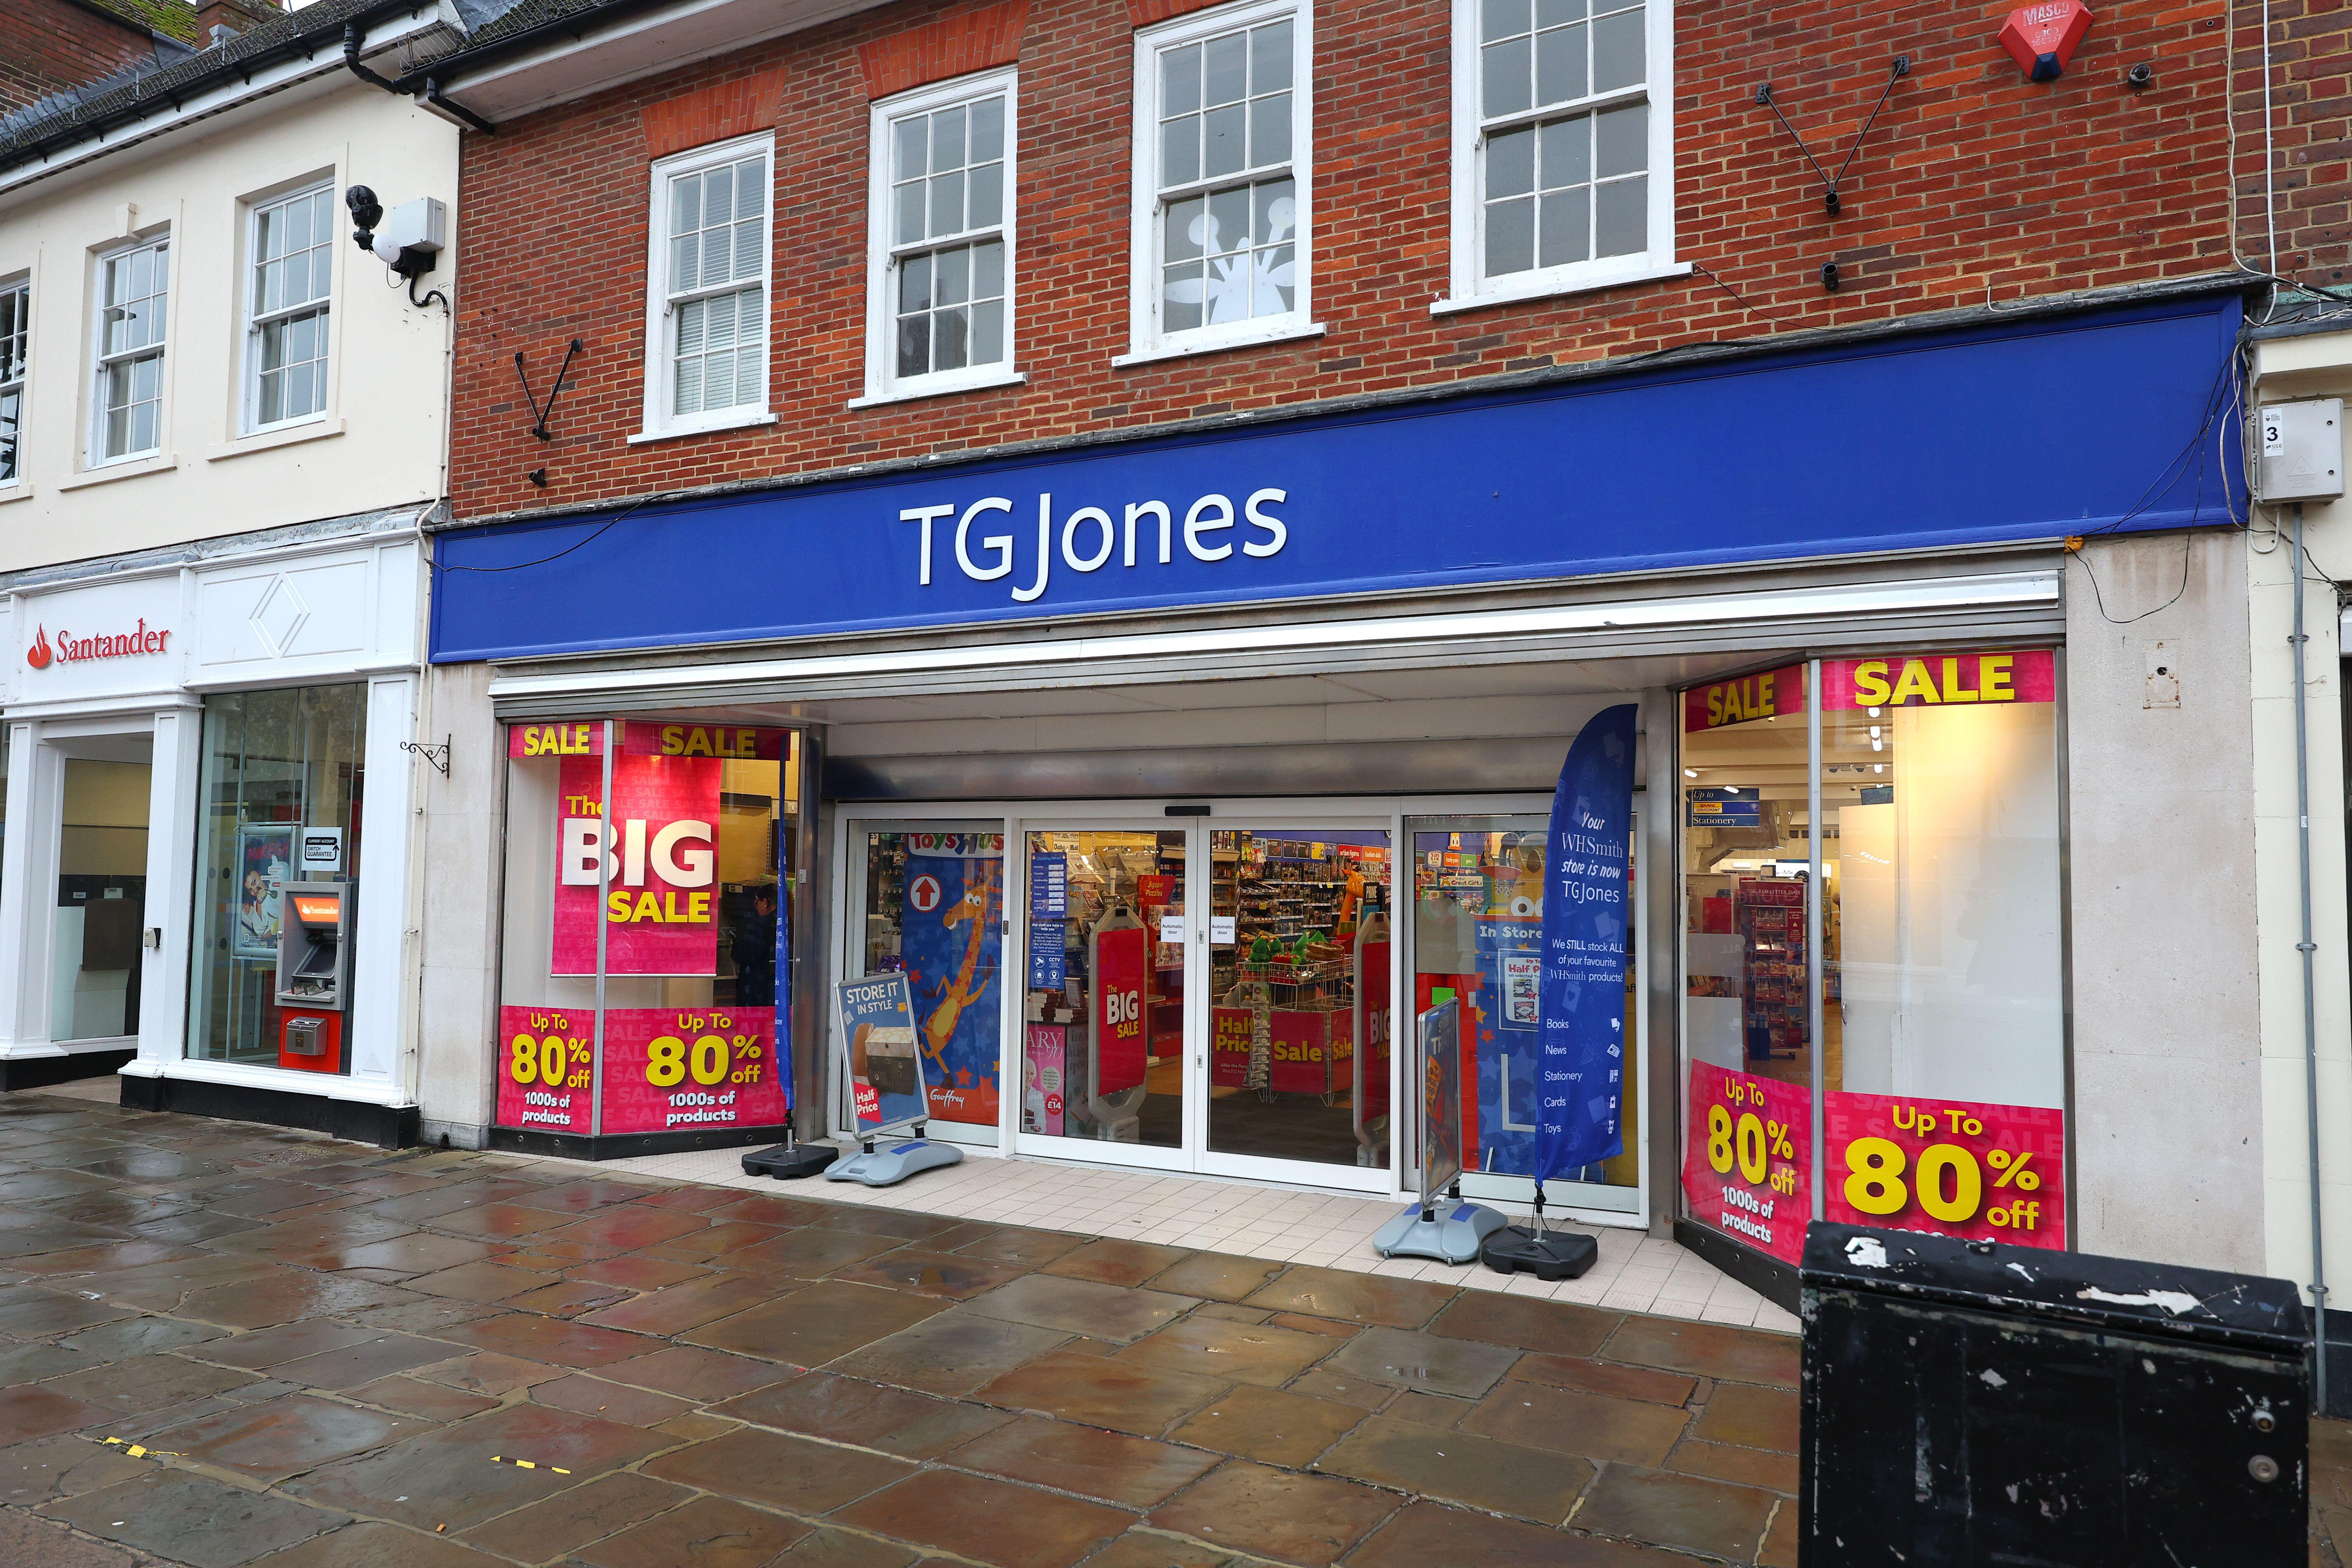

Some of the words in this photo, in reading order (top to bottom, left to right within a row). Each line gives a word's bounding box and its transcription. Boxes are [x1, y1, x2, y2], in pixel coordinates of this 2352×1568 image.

[2023, 2, 2069, 26] MASCO
[2267, 427, 2278, 442] 3
[57, 618, 169, 663] Santander
[1854, 655, 2015, 706] SALE
[1707, 673, 1774, 726] SALE
[524, 724, 590, 756] SALE
[661, 726, 756, 758] SALE
[1693, 791, 1705, 800] Up
[1582, 812, 1605, 830] Your
[1693, 817, 1736, 826] Stationery
[562, 818, 713, 888] BIG
[1054, 844, 1065, 852] Daily
[1562, 832, 1623, 858] WHSmith
[1561, 859, 1585, 875] store
[1587, 860, 1598, 876] is
[1600, 865, 1621, 879] now
[1148, 881, 1164, 889] Jigsaw
[1366, 886, 1377, 899] PRIME
[607, 890, 711, 923] SALE
[1480, 926, 1497, 937] In
[1502, 926, 1542, 939] Store
[1552, 939, 1565, 949] We
[1566, 940, 1586, 950] STILL
[1588, 942, 1608, 952] stock
[1609, 943, 1624, 953] ALL
[1509, 964, 1530, 973] Half
[1558, 954, 1567, 964] of
[1568, 956, 1583, 967] your
[1584, 956, 1616, 967] favourite
[1550, 969, 1586, 980] WHSmith
[1589, 972, 1623, 982] products!
[846, 984, 886, 1004] STORE
[887, 982, 898, 997] IT
[1107, 985, 1117, 993] The
[857, 1004, 867, 1015] IN
[868, 999, 893, 1013] STYLE
[1107, 990, 1138, 1025] BIG
[531, 1012, 549, 1033] Up
[551, 1013, 568, 1030] To
[678, 1013, 704, 1033] Up
[709, 1013, 731, 1028] To
[1117, 1021, 1139, 1038] SALE
[1219, 1016, 1254, 1034] Half
[1547, 1018, 1569, 1029] Books
[1046, 1045, 1063, 1060] 90
[1274, 1040, 1322, 1062] Sale
[1333, 1037, 1353, 1060] Sale
[1377, 1041, 1390, 1059] SAL
[1546, 1045, 1567, 1055] News
[511, 1033, 591, 1086] 80%
[645, 1034, 762, 1087] 80%
[567, 1069, 590, 1089] off
[731, 1064, 760, 1084] off
[1544, 1070, 1582, 1082] Stationery
[525, 1091, 557, 1107] 1000s
[559, 1094, 571, 1108] of
[668, 1093, 715, 1107] 1000s
[718, 1090, 736, 1105] of
[856, 1089, 875, 1104] Half
[930, 1089, 965, 1109] Geoffrey
[1726, 1076, 1744, 1106] Up
[1746, 1082, 1764, 1107] To
[857, 1103, 878, 1116] Price
[1047, 1101, 1061, 1110] £14
[1544, 1096, 1566, 1107] Cards
[522, 1109, 571, 1125] products
[666, 1109, 736, 1127] products
[1893, 1105, 1936, 1137] Up
[1943, 1109, 1982, 1136] To
[1544, 1123, 1561, 1135] Toys
[1708, 1104, 1793, 1185] 80%
[1770, 1167, 1795, 1196] off
[1844, 1137, 2040, 1222] 80%
[1721, 1185, 1759, 1214] 1000s
[1761, 1200, 1773, 1219] of
[1987, 1200, 2039, 1230] off
[1721, 1211, 1771, 1244] products
